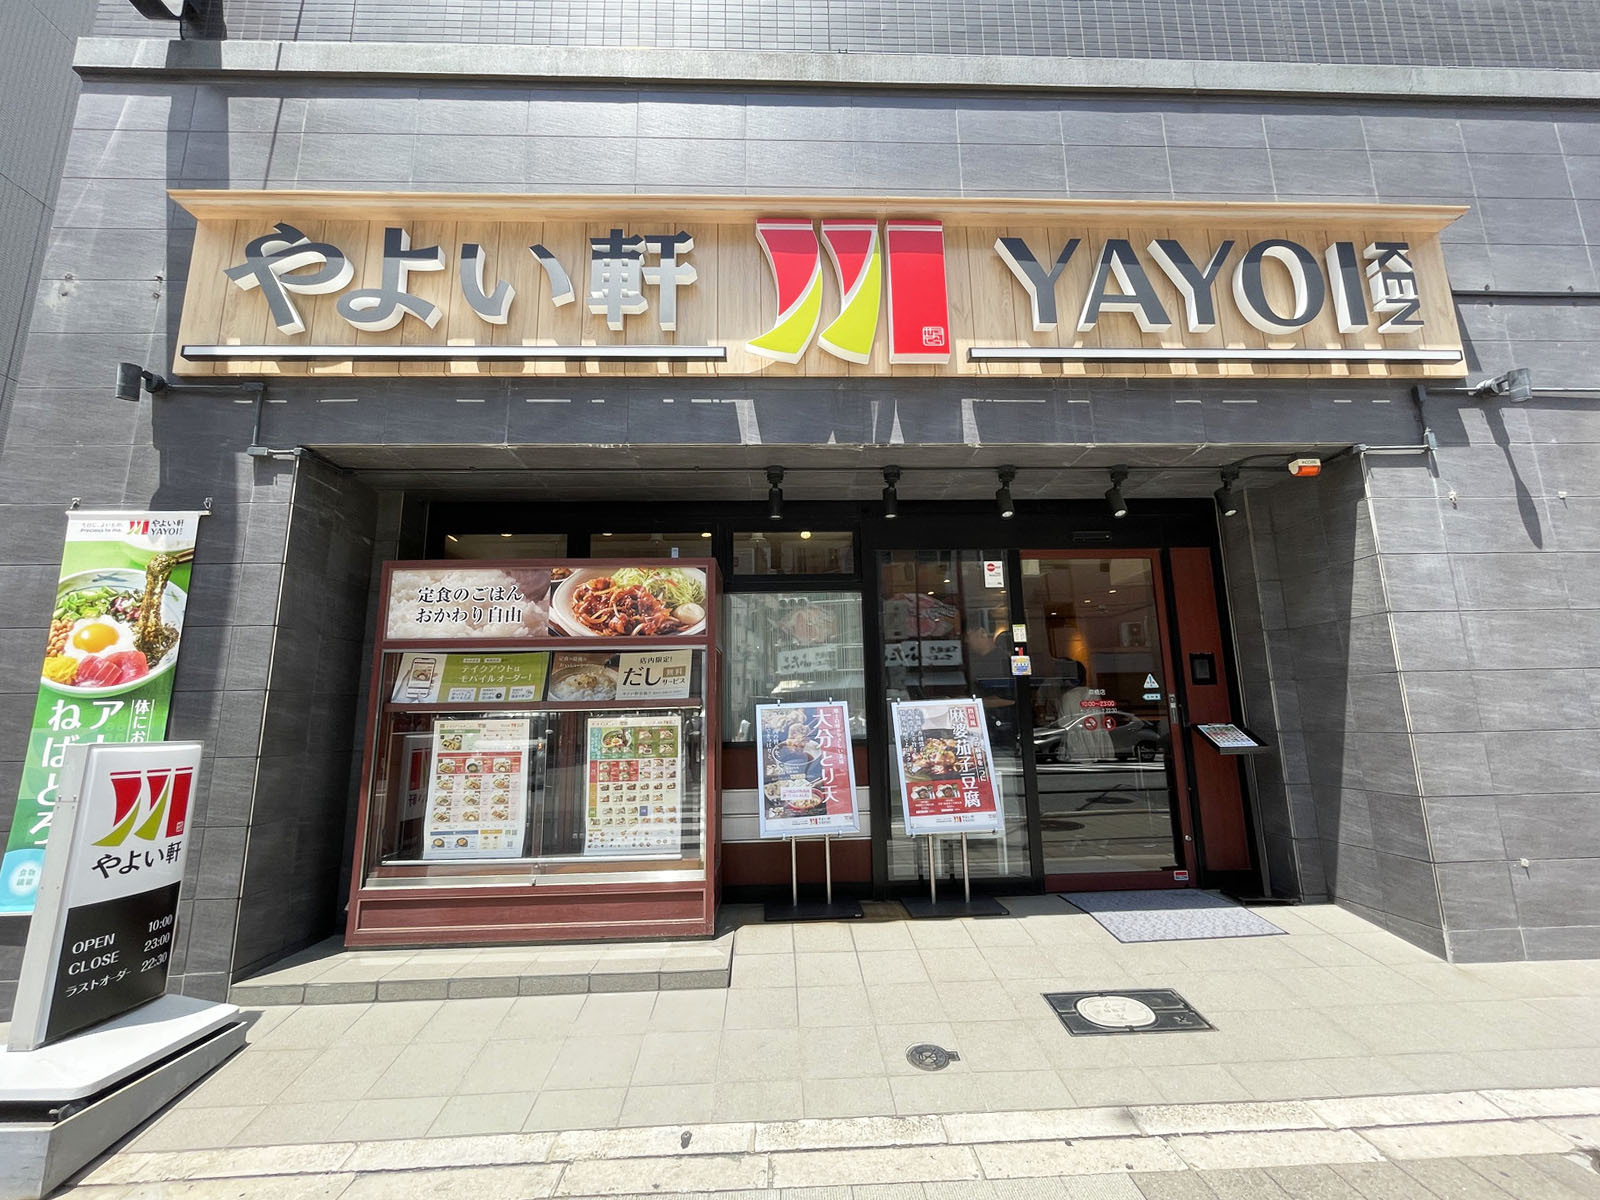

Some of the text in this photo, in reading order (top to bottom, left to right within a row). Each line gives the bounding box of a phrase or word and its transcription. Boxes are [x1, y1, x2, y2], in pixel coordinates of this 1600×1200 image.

[223, 222, 698, 336] やよい軒
[994, 237, 1369, 335] YAYOI
[1366, 241, 1425, 334] KEN
[415, 606, 523, 624] おかわり自由
[418, 586, 525, 603] 定食のごはん
[622, 666, 662, 687] だし
[812, 708, 840, 804] 大分とり天
[949, 706, 982, 808] 麻婆茄子豆腐
[91, 841, 182, 879] やよい軒
[68, 931, 171, 976] CLOSE 23:00
[72, 913, 174, 955] OPEN 10:00
[65, 951, 168, 998] ラストオーダー 22:30
